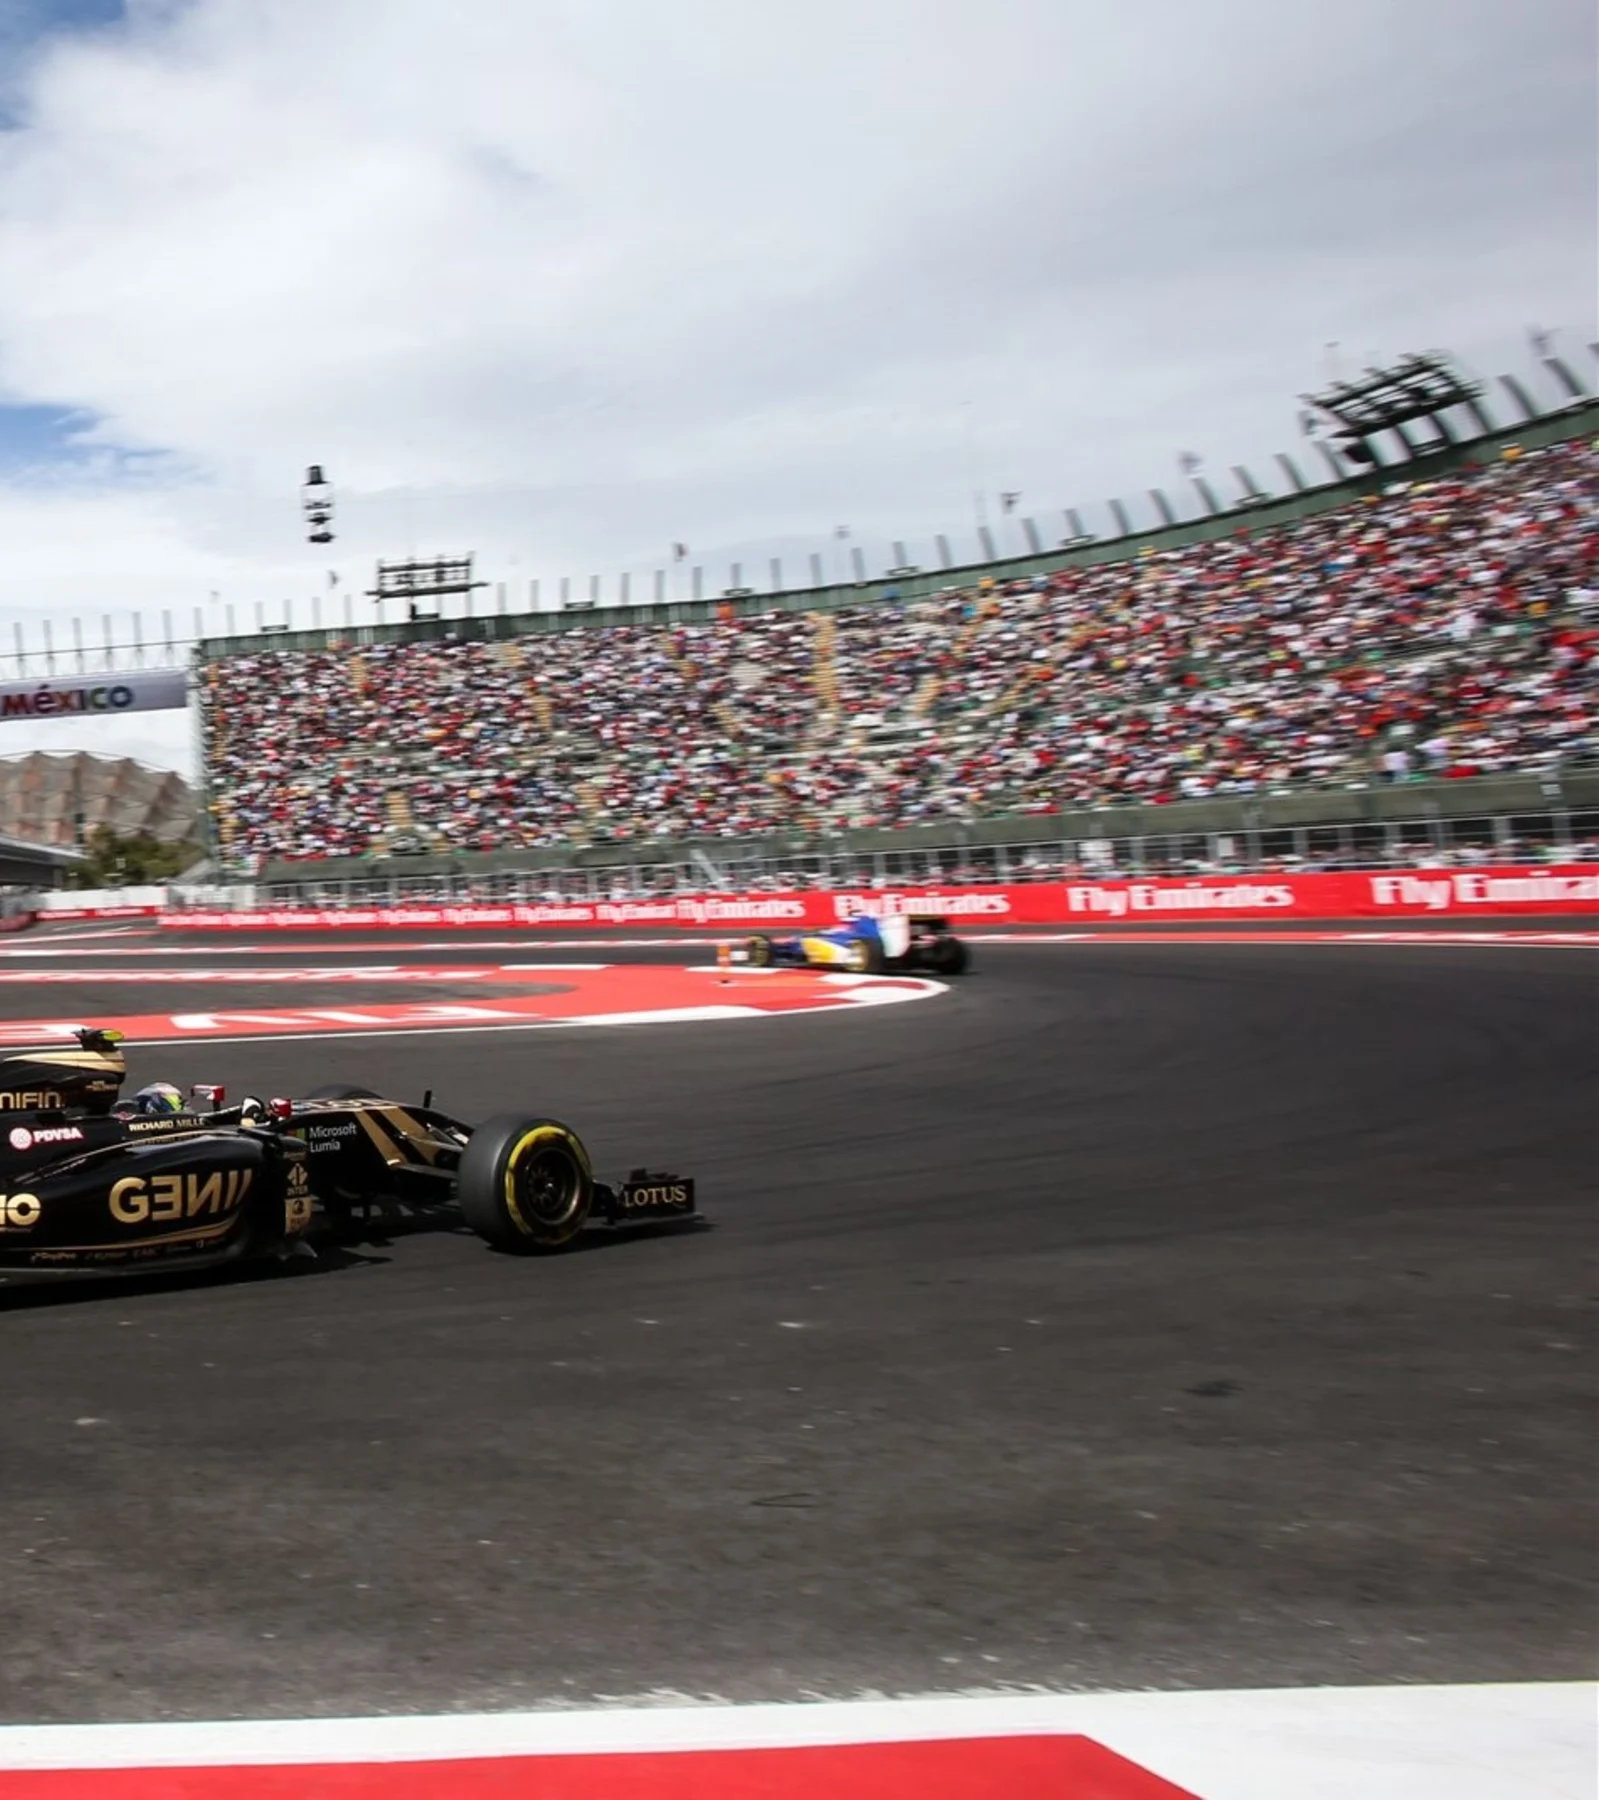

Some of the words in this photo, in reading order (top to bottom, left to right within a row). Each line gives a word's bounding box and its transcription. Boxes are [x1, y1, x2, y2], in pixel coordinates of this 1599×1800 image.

[881, 891, 1011, 915] Emirates
[1067, 887, 1129, 916] Fly
[1129, 882, 1294, 910] Emirates
[1370, 876, 1450, 909] Fly
[33, 1127, 84, 1143] PDVSA
[309, 1121, 358, 1138] Microsoft
[309, 1139, 341, 1153] Lumia
[623, 1185, 687, 1208] LOTUS
